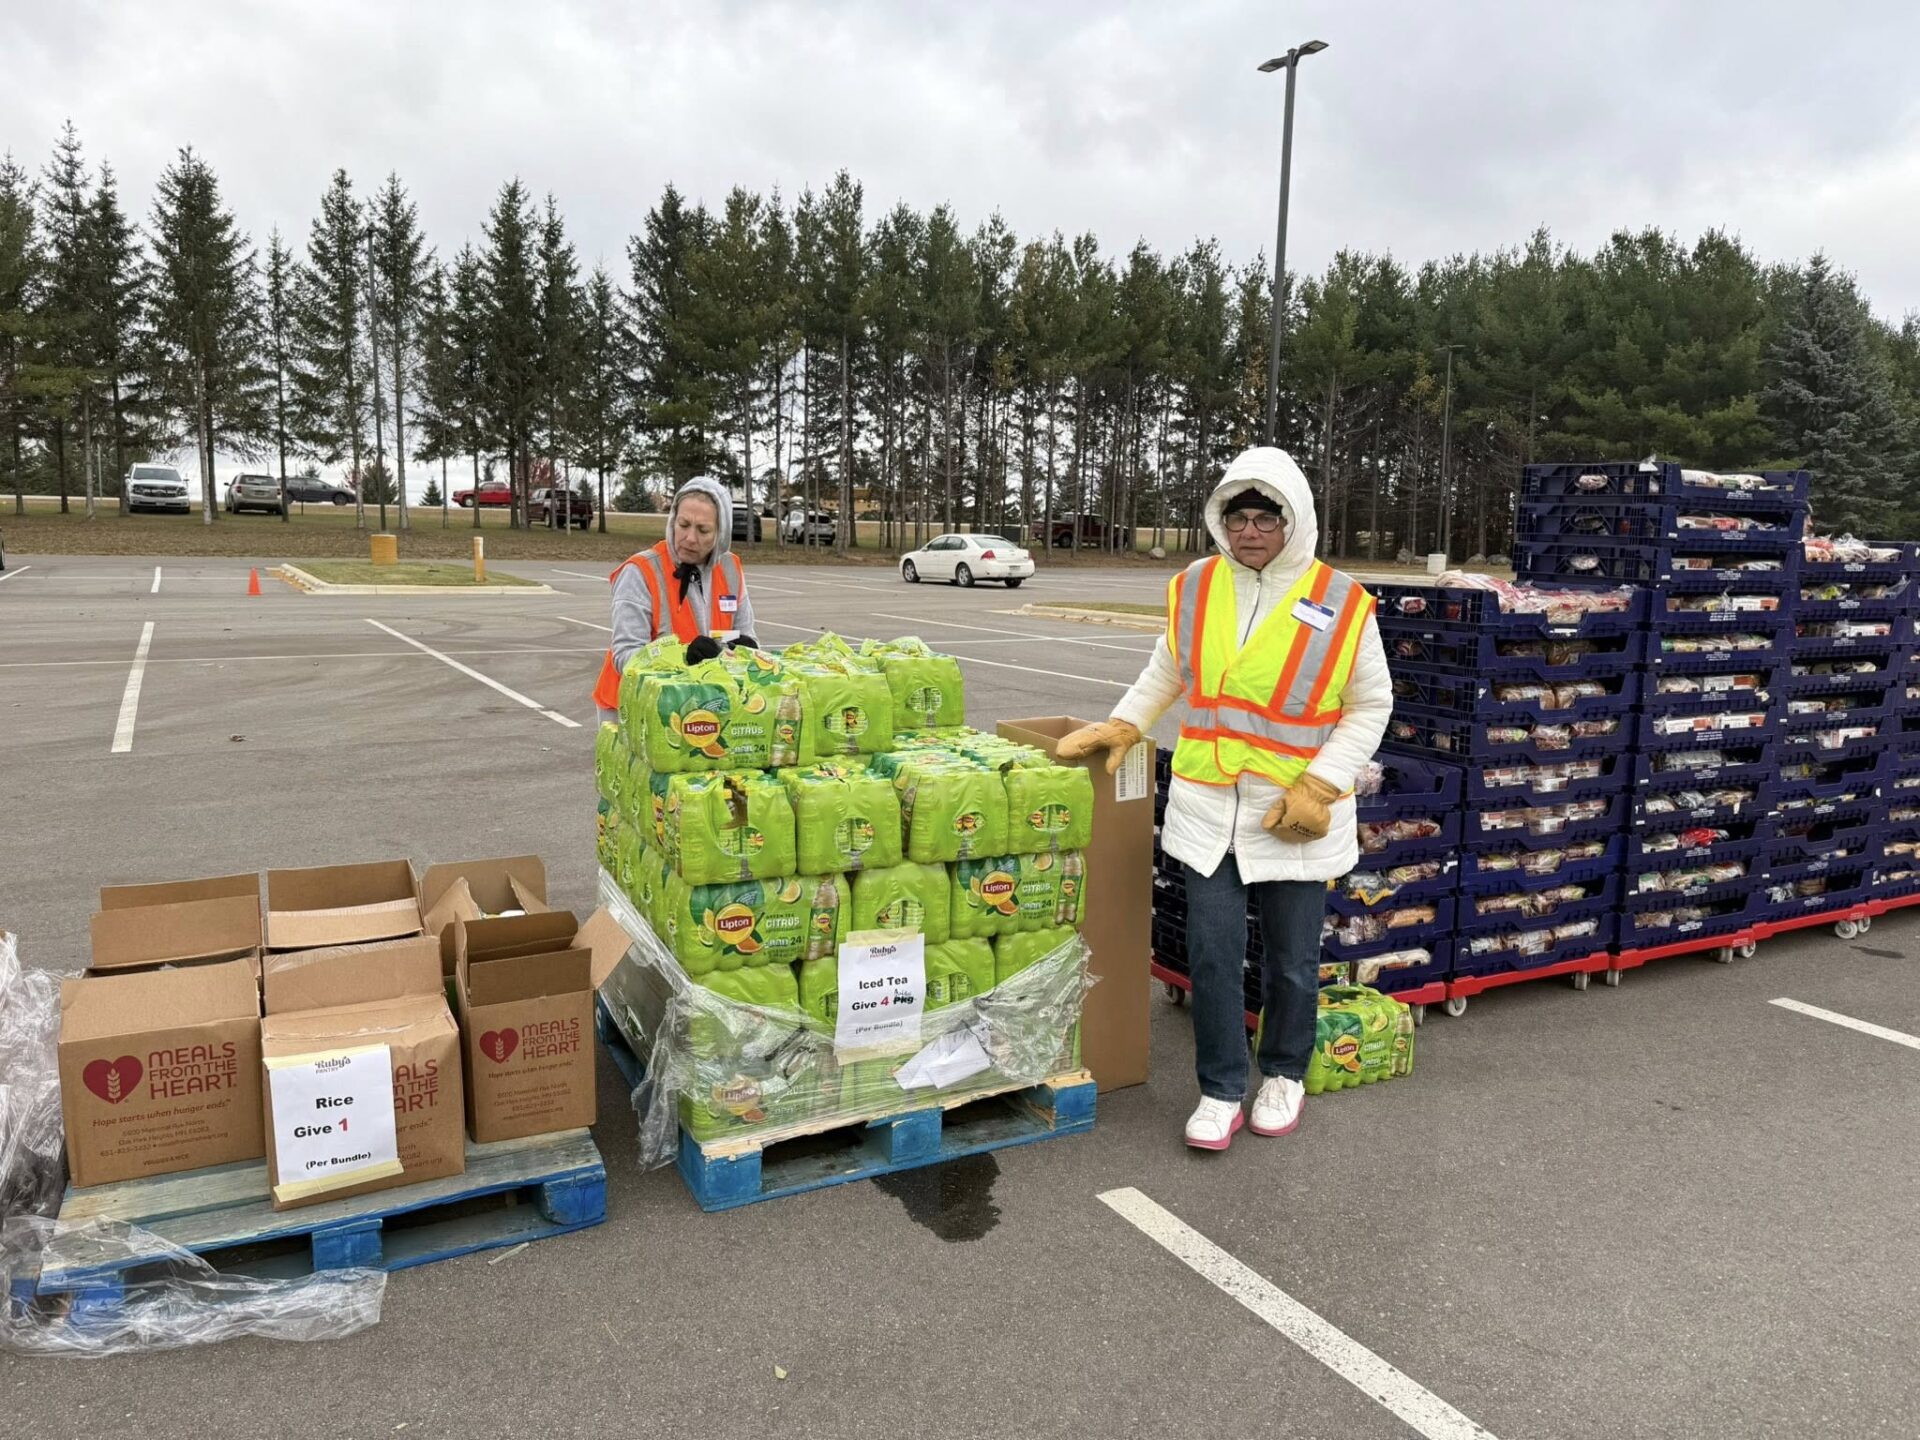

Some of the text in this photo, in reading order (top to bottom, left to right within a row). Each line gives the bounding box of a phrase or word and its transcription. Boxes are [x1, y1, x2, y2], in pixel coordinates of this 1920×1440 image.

[687, 722, 716, 733] Lipton
[731, 726, 764, 736] CITRUS
[985, 882, 1010, 893] Lipton
[720, 918, 749, 929] Lipton
[765, 916, 800, 929] CITRUS
[859, 976, 908, 990] Iced Tea
[852, 1001, 878, 1011] Give
[880, 996, 890, 1006] 4
[522, 1017, 580, 1038] MEALS
[522, 1030, 580, 1048] FROM THE
[148, 1041, 236, 1069] MEALS
[523, 1039, 580, 1061] HEART
[149, 1058, 237, 1082] FROM THE
[315, 1056, 351, 1069] Ruby's
[395, 1058, 438, 1083] ALS
[150, 1071, 237, 1100] HEART
[408, 1076, 438, 1093] THE
[316, 1095, 354, 1109] Rice
[394, 1089, 438, 1114] ART
[92, 1117, 117, 1128] Hope
[119, 1113, 145, 1124] starts
[147, 1109, 172, 1120] when
[173, 1104, 204, 1116] hunger
[294, 1118, 349, 1138] Give 1
[305, 1152, 372, 1170] (Per Bundle)
